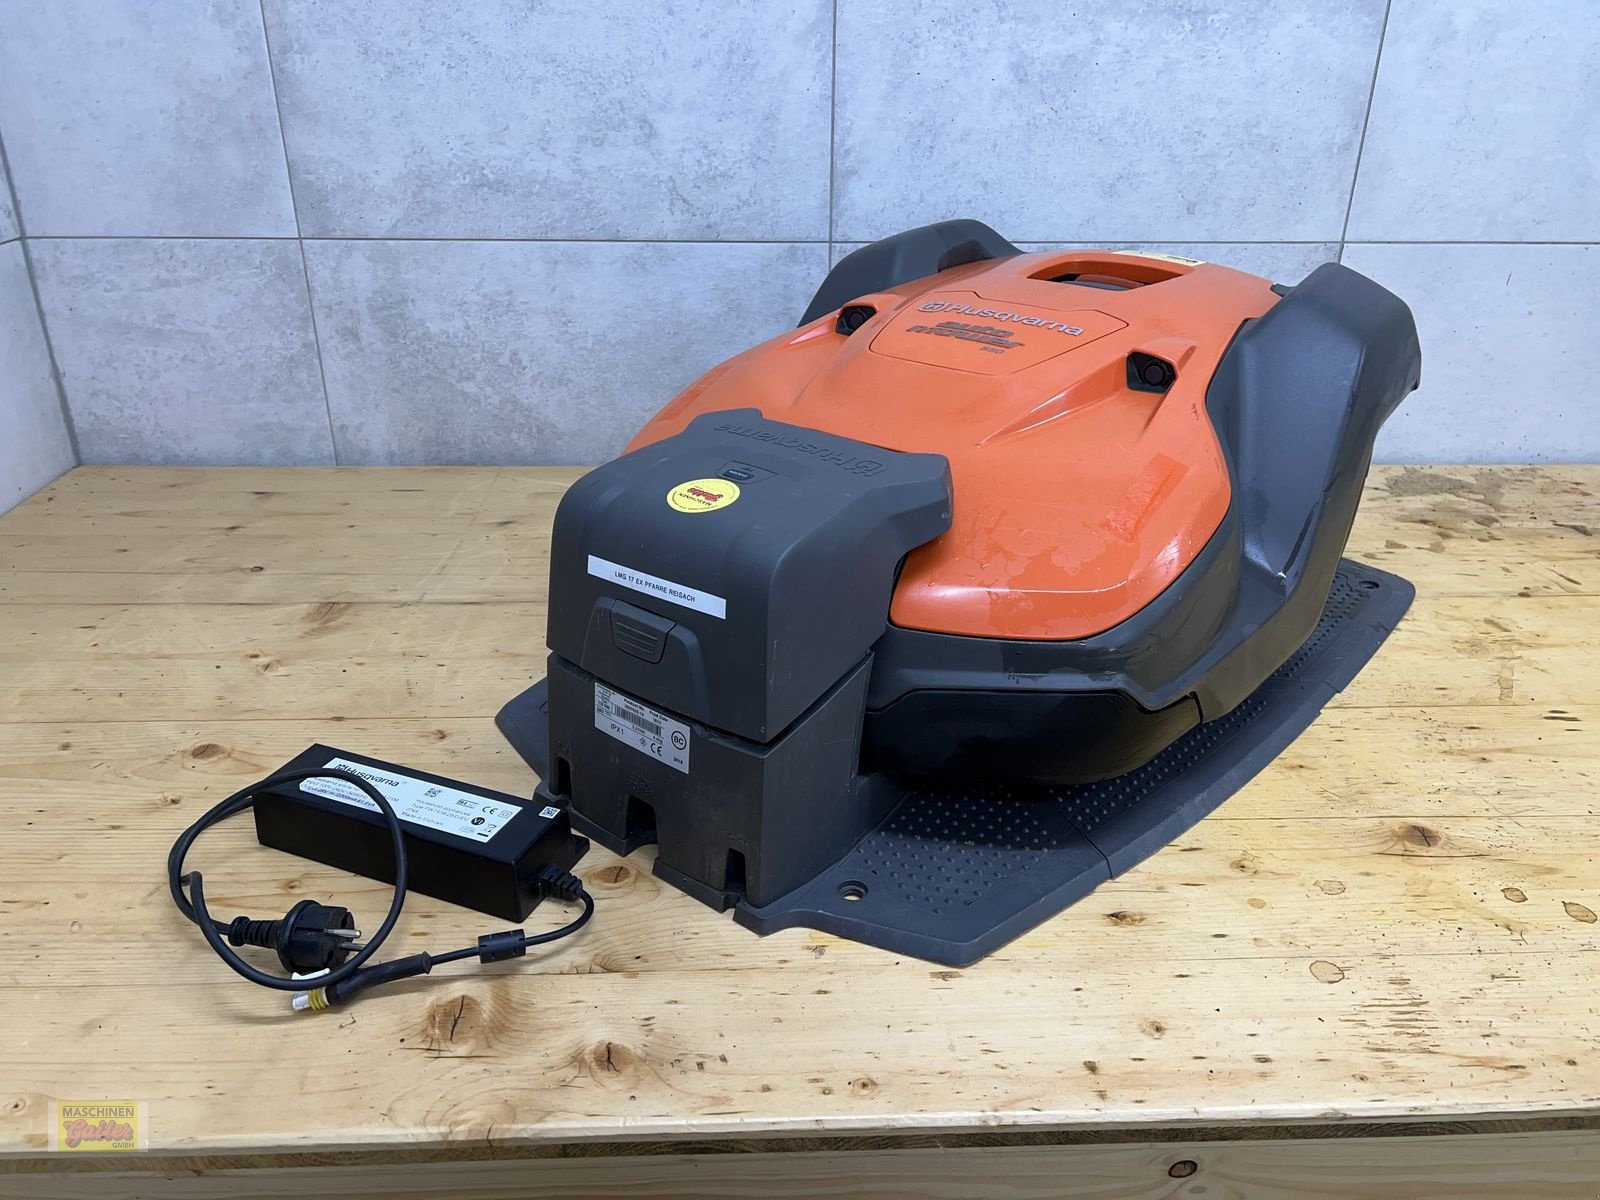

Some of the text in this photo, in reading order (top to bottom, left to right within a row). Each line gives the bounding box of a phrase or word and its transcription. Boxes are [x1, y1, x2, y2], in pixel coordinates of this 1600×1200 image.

[944, 303, 1084, 336] Husqvarna
[713, 424, 857, 467] Husqvarna
[614, 571, 627, 580] LMG
[636, 578, 644, 586] EX
[644, 581, 668, 594] PFARRE
[669, 588, 696, 603] REISACH
[610, 722, 624, 736] IPX1
[673, 735, 684, 746] BC
[346, 765, 400, 787] Husqvarna
